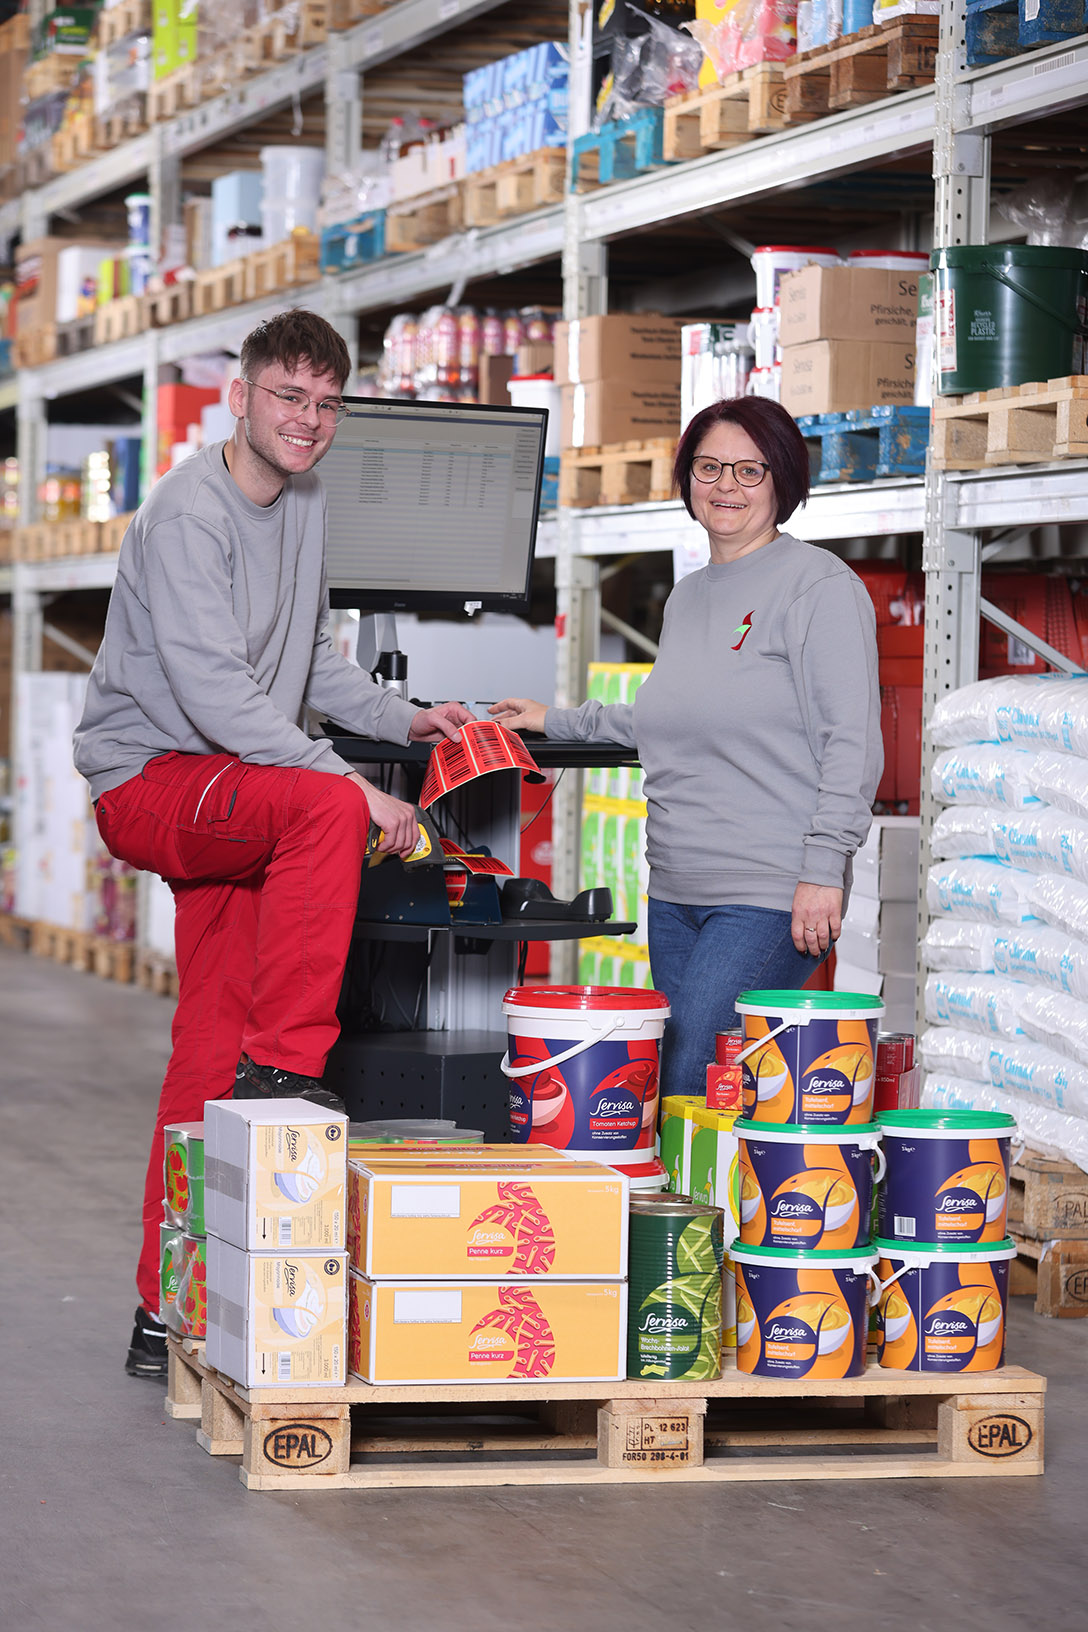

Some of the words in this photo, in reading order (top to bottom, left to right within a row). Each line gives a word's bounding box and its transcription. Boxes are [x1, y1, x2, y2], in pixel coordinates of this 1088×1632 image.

[802, 1076, 844, 1094] Servisa
[590, 1098, 634, 1117] Servisa
[286, 1125, 300, 1162] Servisa
[770, 1200, 814, 1217] Servisa
[935, 1195, 978, 1212] Servisa
[467, 1229, 506, 1246] Servisa
[284, 1258, 298, 1297] Servisa
[638, 1312, 688, 1334] Servisa
[764, 1323, 808, 1340] Servisa
[924, 1318, 968, 1336] Servisa
[468, 1334, 507, 1350] Servisa
[670, 1423, 686, 1432] 623
[978, 1424, 1022, 1448] EPAL
[274, 1434, 322, 1458] EPAL
[644, 1436, 655, 1444] HT
